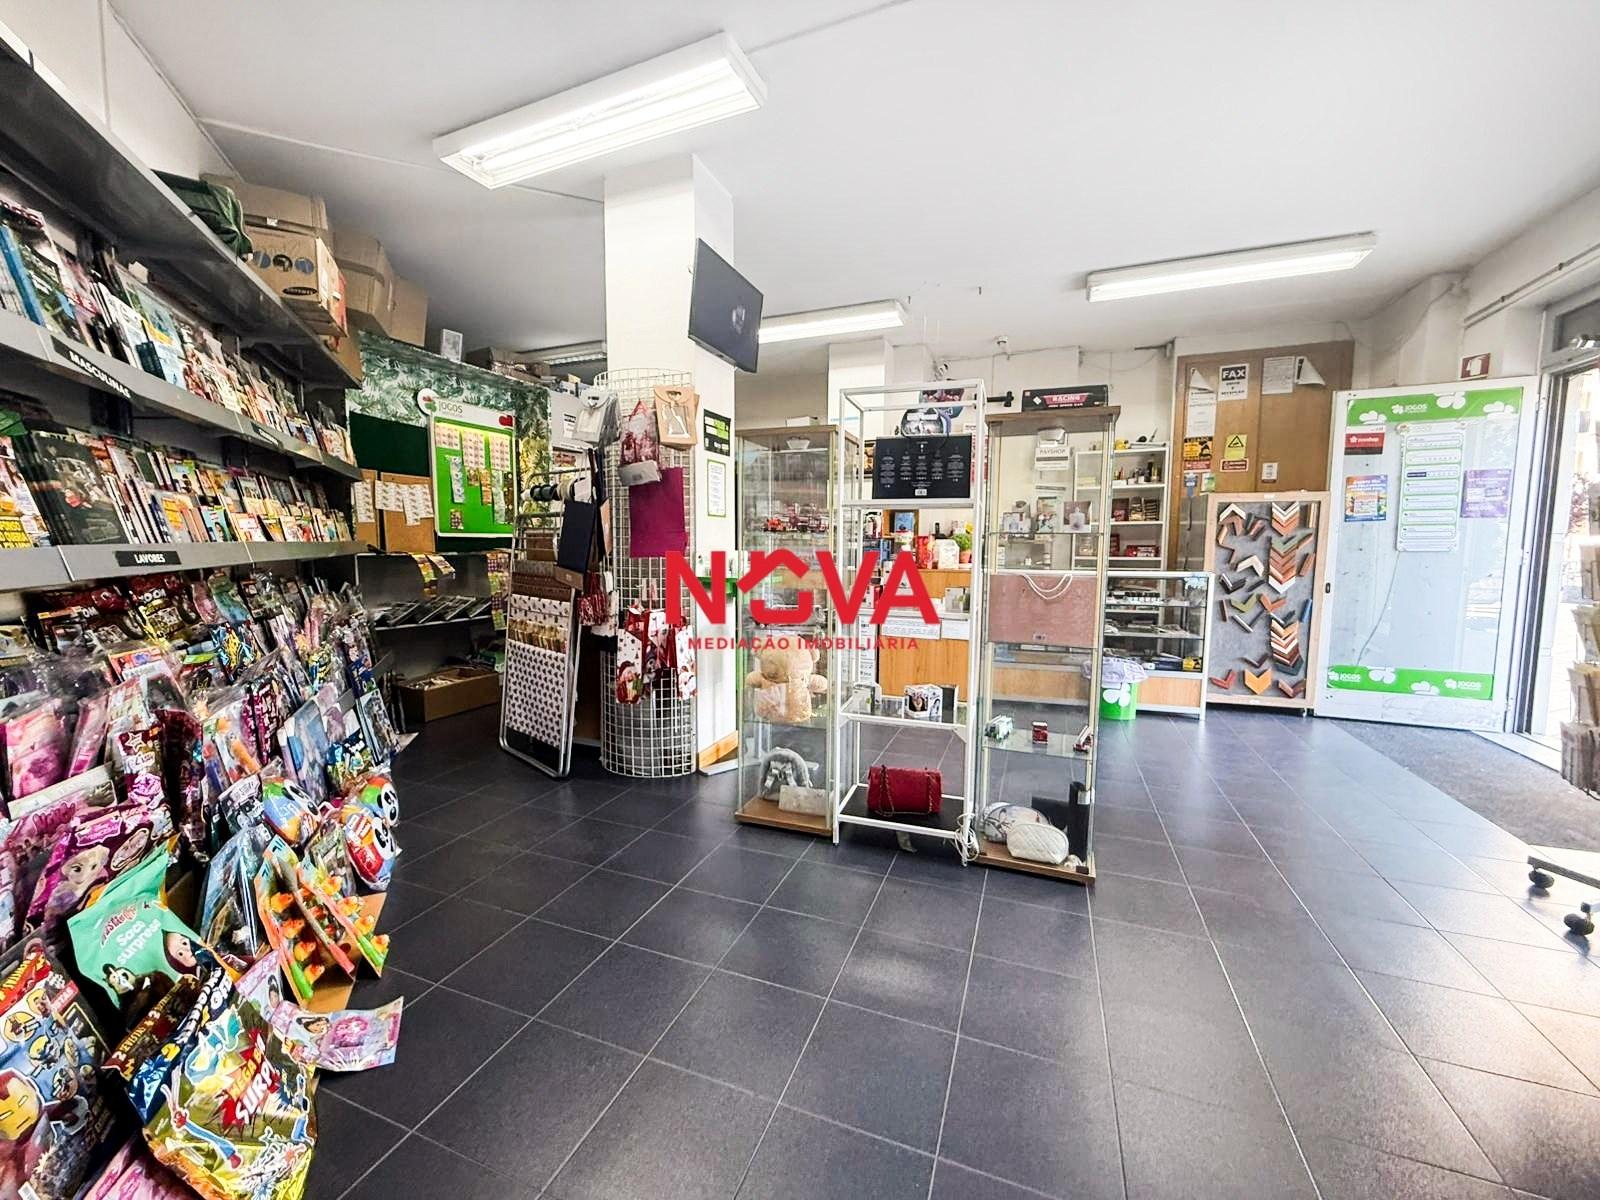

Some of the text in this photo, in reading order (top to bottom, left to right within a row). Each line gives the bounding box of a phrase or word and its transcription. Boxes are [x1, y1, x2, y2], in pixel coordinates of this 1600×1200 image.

[1222, 369, 1246, 378] FAX
[134, 553, 166, 564] LAVORES
[229, 1057, 258, 1102] MEGA
[235, 1060, 274, 1125] SURP
